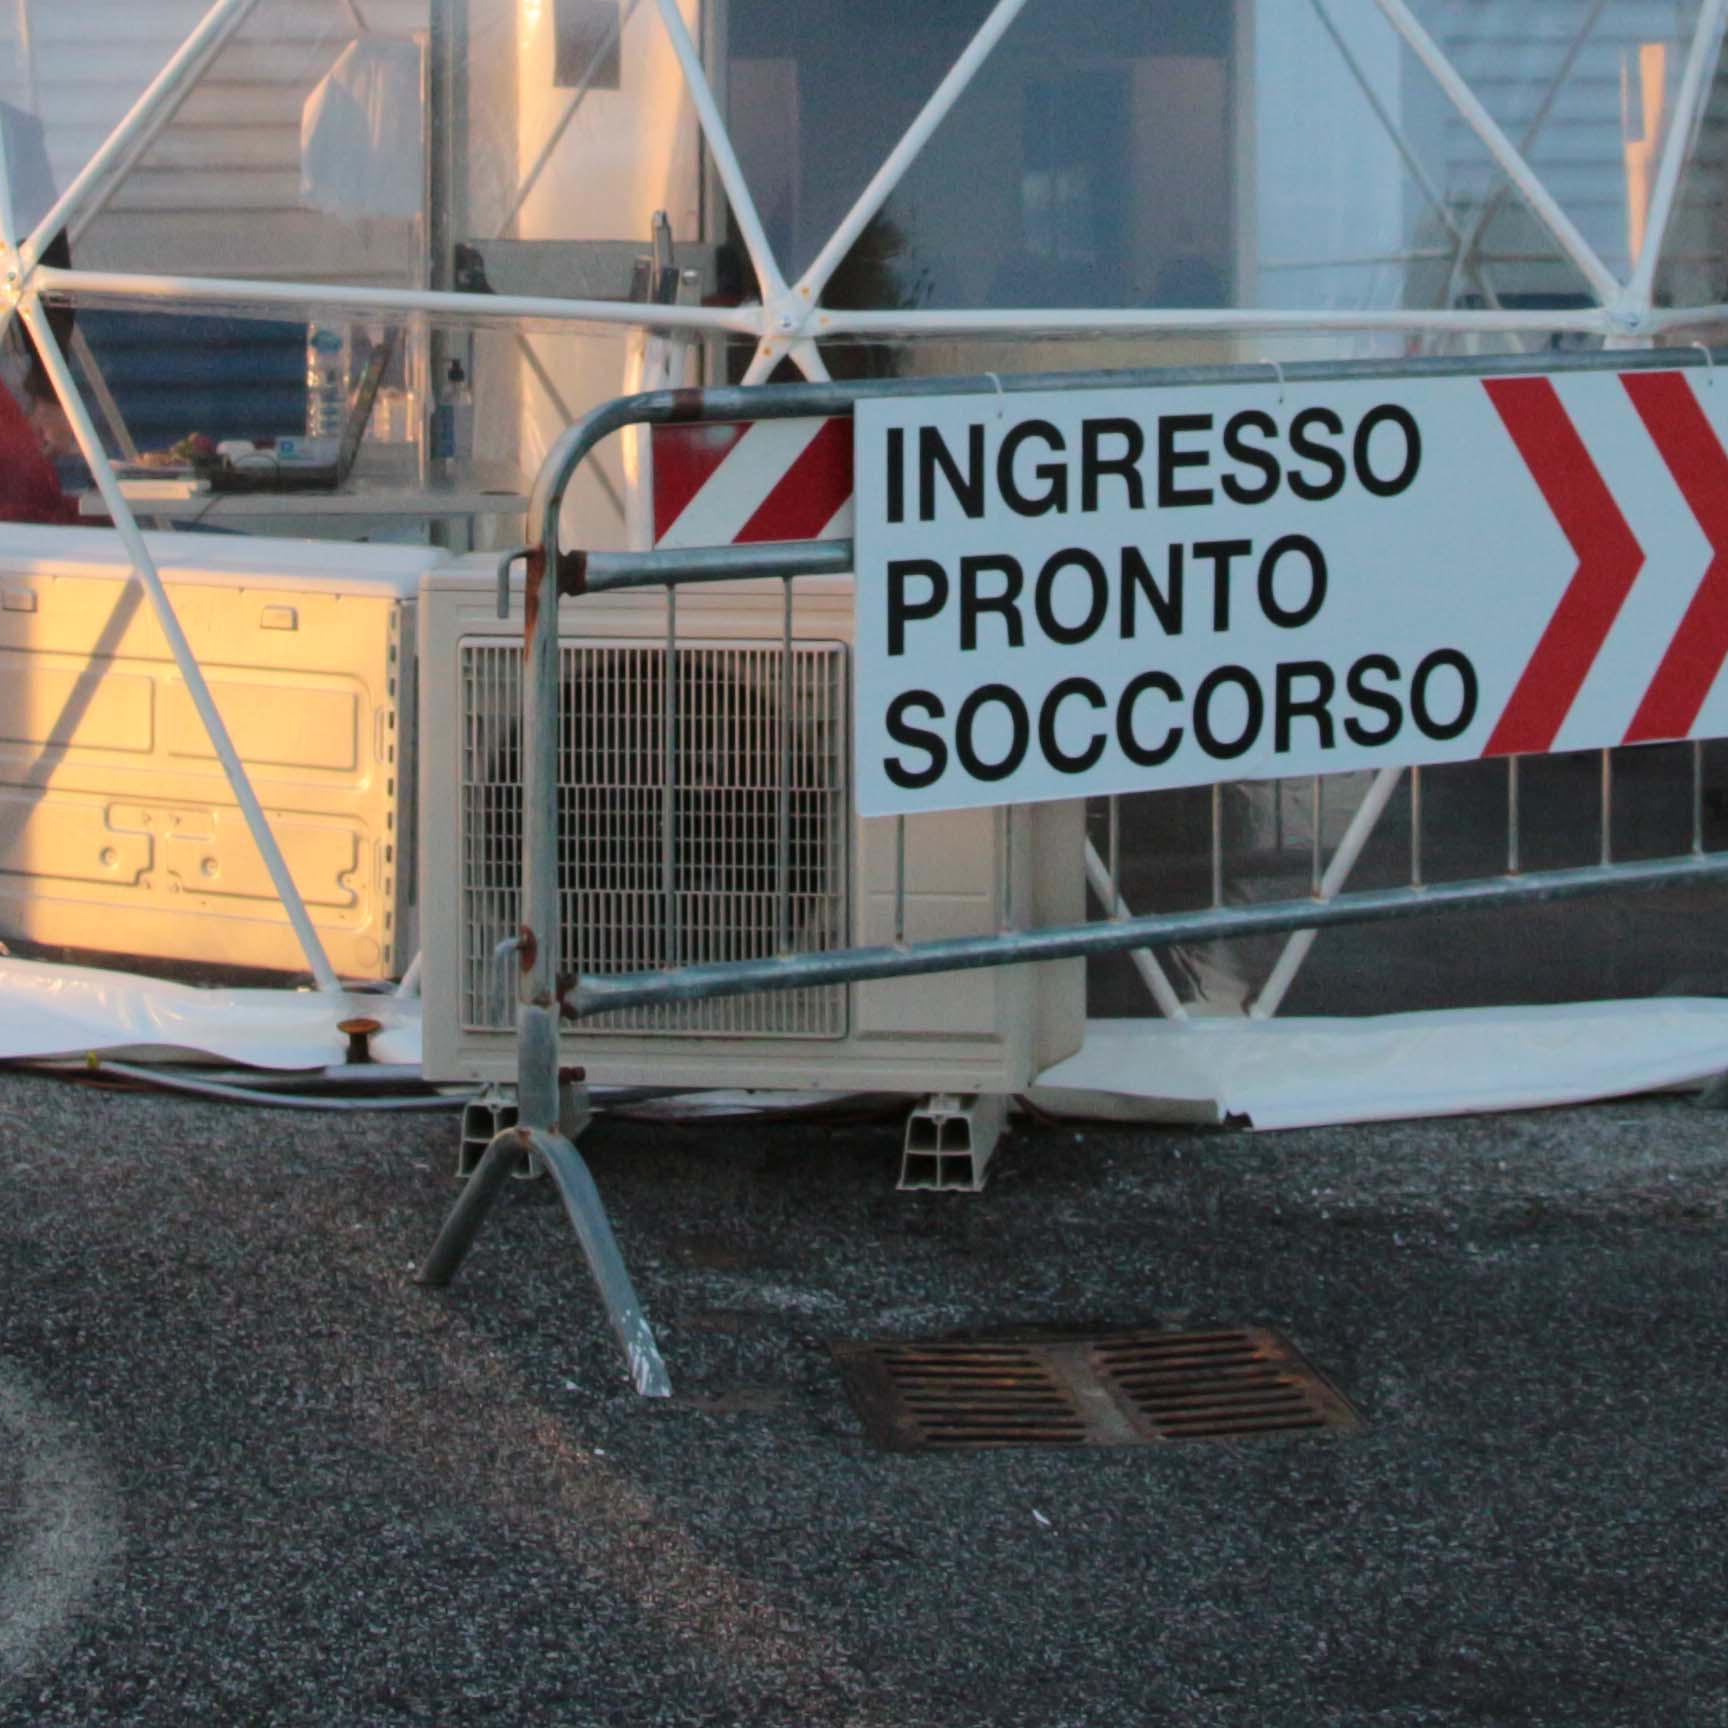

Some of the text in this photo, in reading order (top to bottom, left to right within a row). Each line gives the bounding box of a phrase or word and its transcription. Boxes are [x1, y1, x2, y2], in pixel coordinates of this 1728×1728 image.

[883, 403, 1421, 523] INGRESSO
[888, 534, 1327, 656] PRONTO
[884, 647, 1479, 790] SOCCORSO
